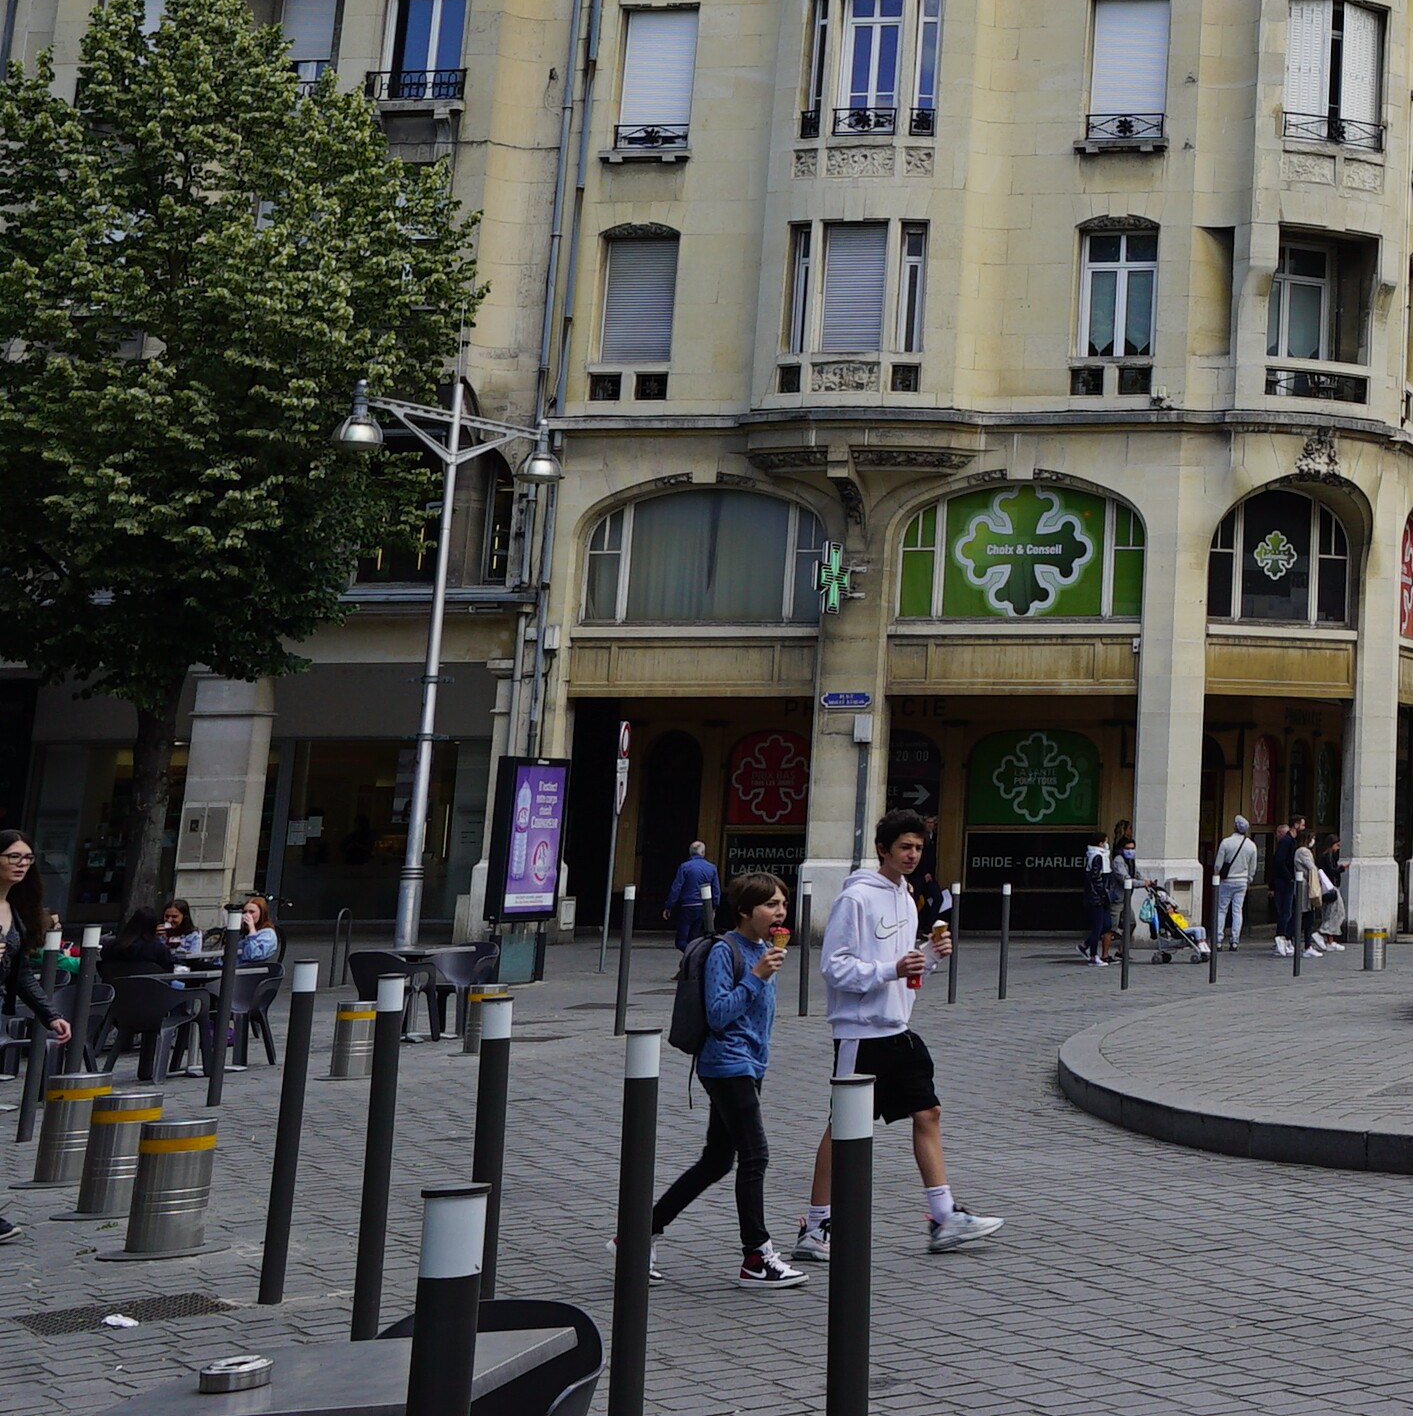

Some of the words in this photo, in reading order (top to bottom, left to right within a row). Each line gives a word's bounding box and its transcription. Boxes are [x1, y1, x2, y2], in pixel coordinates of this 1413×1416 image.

[986, 544, 1014, 555] Choix
[1016, 545, 1024, 555] &
[1026, 544, 1063, 555] Conseil
[728, 847, 806, 859] PHARMACIE
[972, 856, 1013, 868] BRIDE
